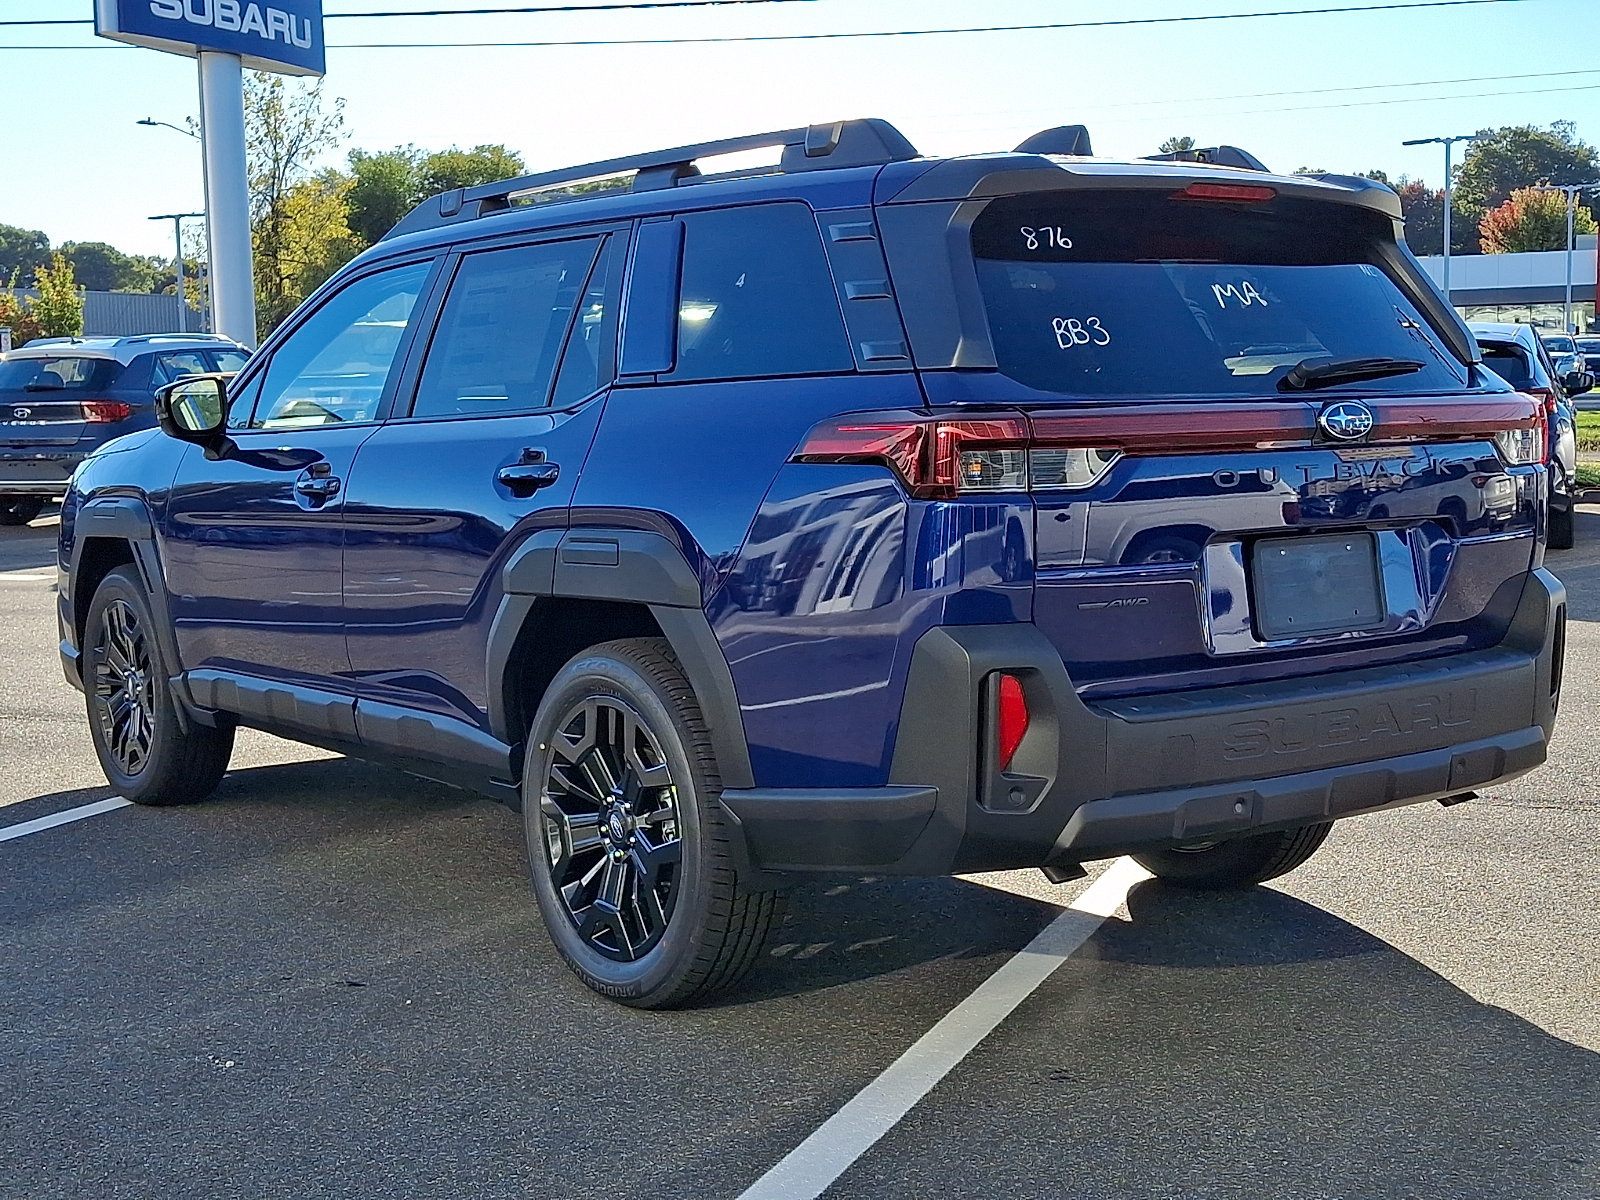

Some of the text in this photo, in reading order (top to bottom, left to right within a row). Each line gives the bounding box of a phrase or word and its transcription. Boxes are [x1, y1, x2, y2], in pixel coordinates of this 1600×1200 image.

[149, 0, 312, 49] SUBARU
[1020, 226, 1073, 250] 876
[1211, 280, 1268, 309] MA
[1052, 316, 1111, 350] BB3
[1212, 457, 1452, 488] OUTBACK
[1105, 597, 1150, 608] AWD
[1223, 688, 1478, 760] SUBARU
